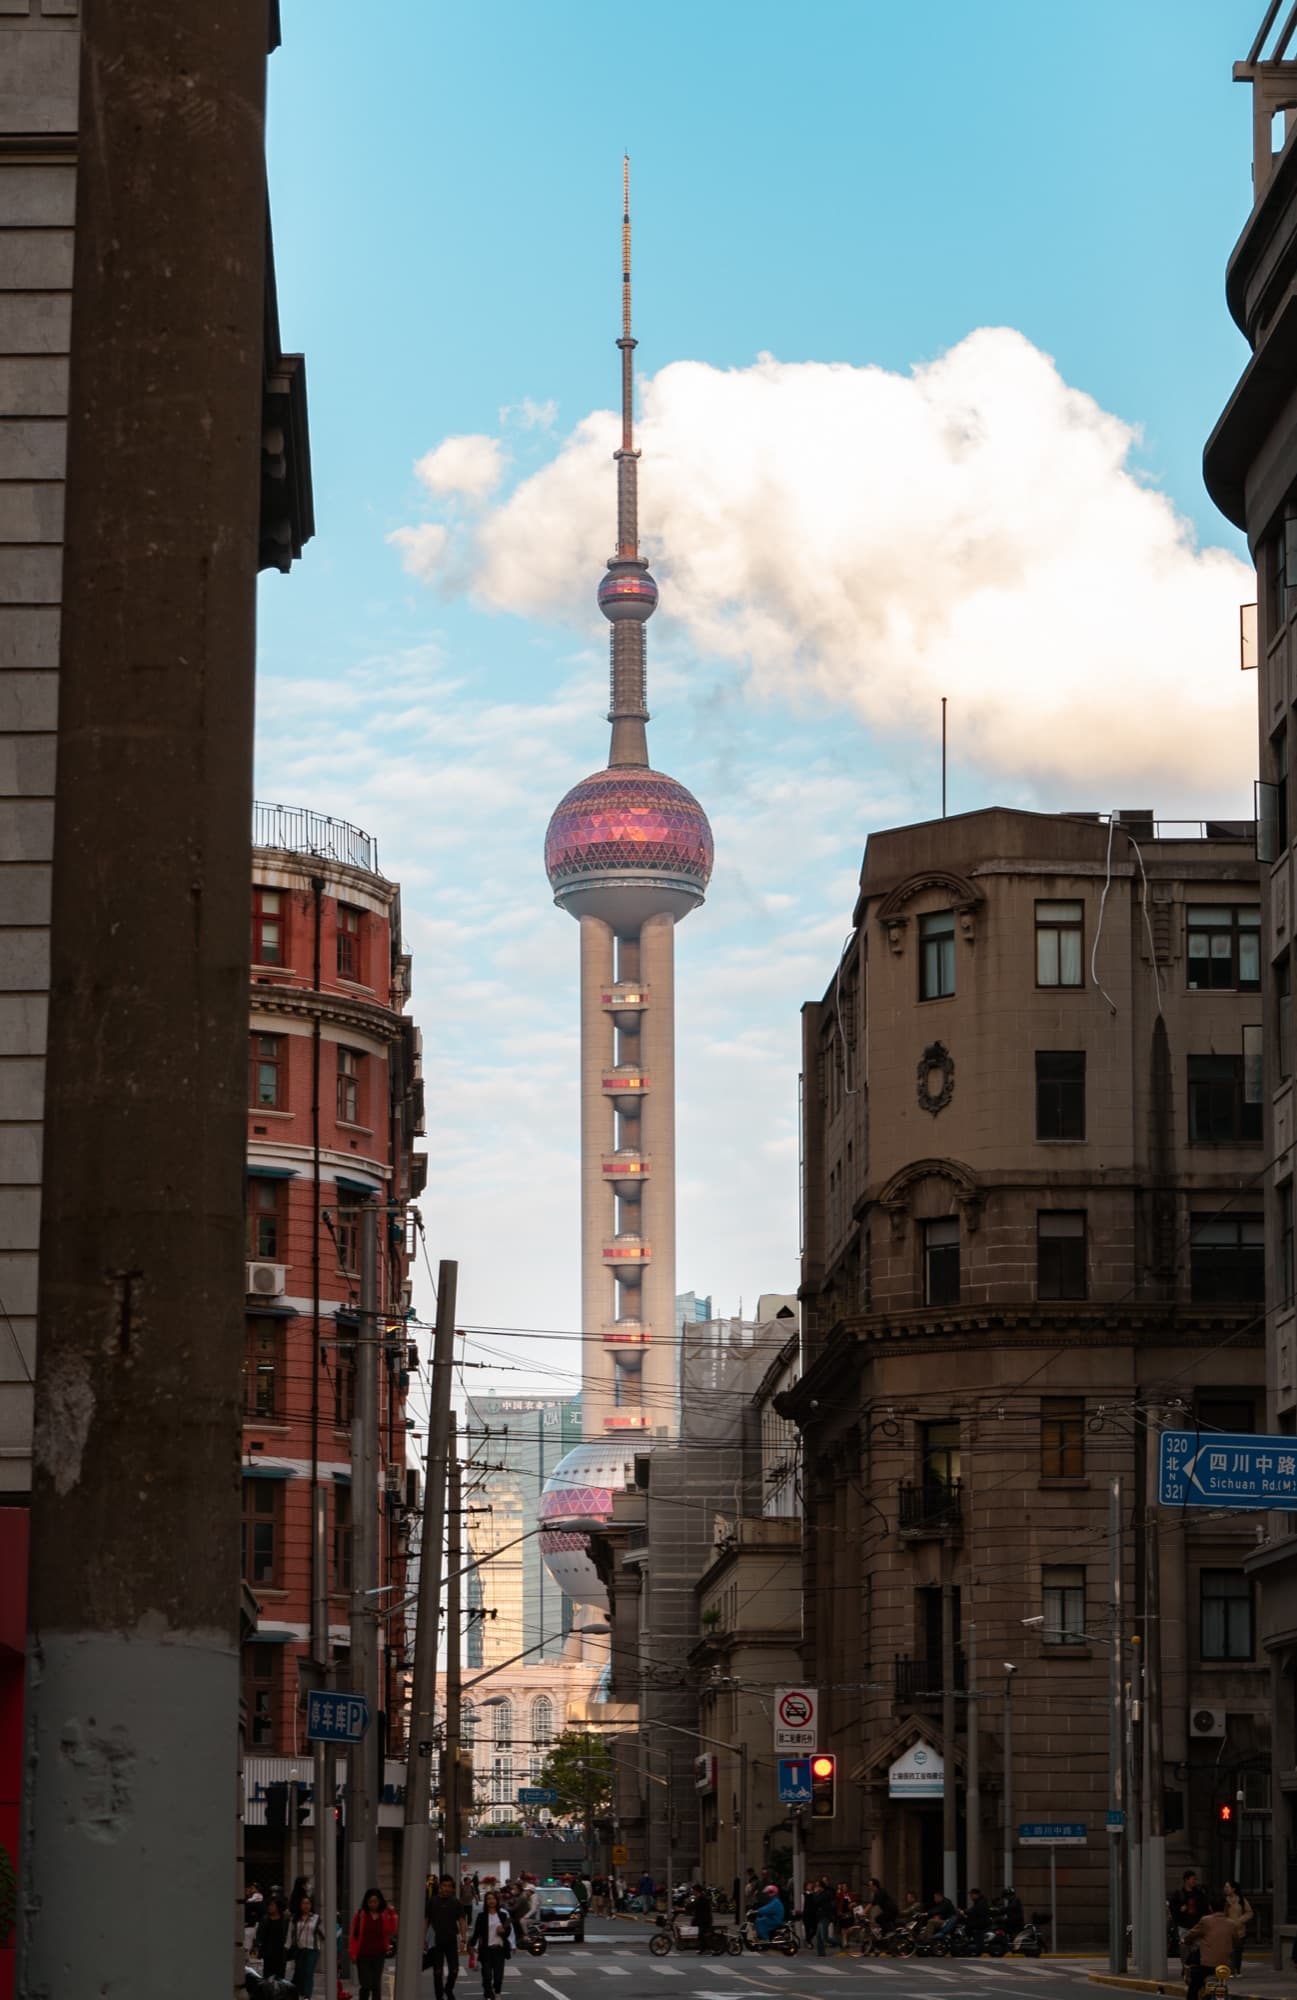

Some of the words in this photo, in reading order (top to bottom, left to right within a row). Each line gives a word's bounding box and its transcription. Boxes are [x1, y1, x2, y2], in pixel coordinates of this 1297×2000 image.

[1166, 1438, 1188, 1453] 320
[1166, 1456, 1180, 1471] 北
[1209, 1453, 1297, 1476] 四川中路
[1169, 1472, 1176, 1481] N
[1209, 1477, 1256, 1490] Sichuan
[1165, 1484, 1183, 1499] 321
[311, 1698, 347, 1733] 停车库
